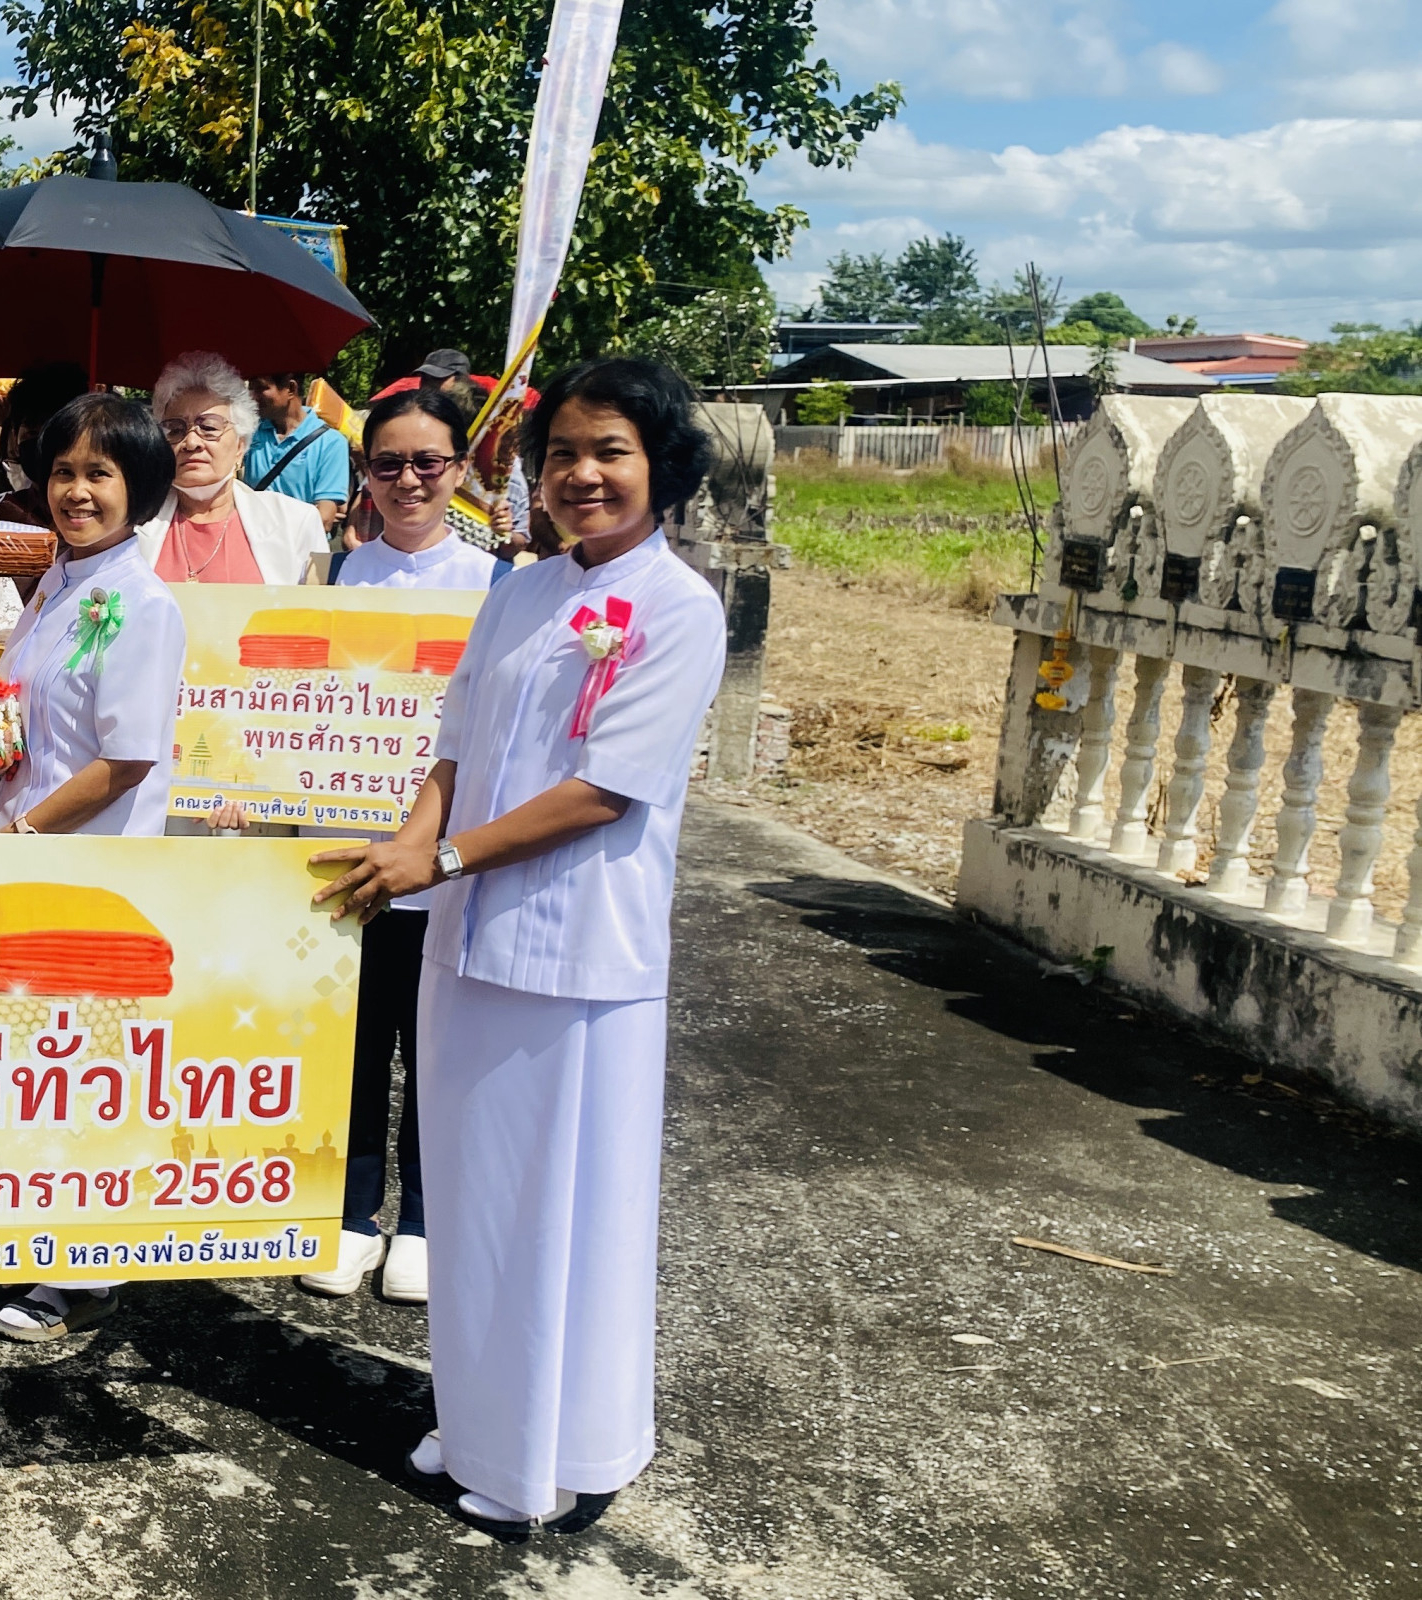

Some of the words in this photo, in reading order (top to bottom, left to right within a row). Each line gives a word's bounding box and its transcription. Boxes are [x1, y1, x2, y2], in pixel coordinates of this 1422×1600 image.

[244, 724, 402, 758] พุทธศักราช
[416, 735, 431, 758] 2
[299, 767, 426, 806] จ.สระบุรี
[314, 806, 392, 824] บูชาธรรม
[154, 1160, 292, 1206] 2568
[32, 1236, 54, 1267] ปี
[68, 1227, 318, 1267] หลวงพ่อธัมมชโย
